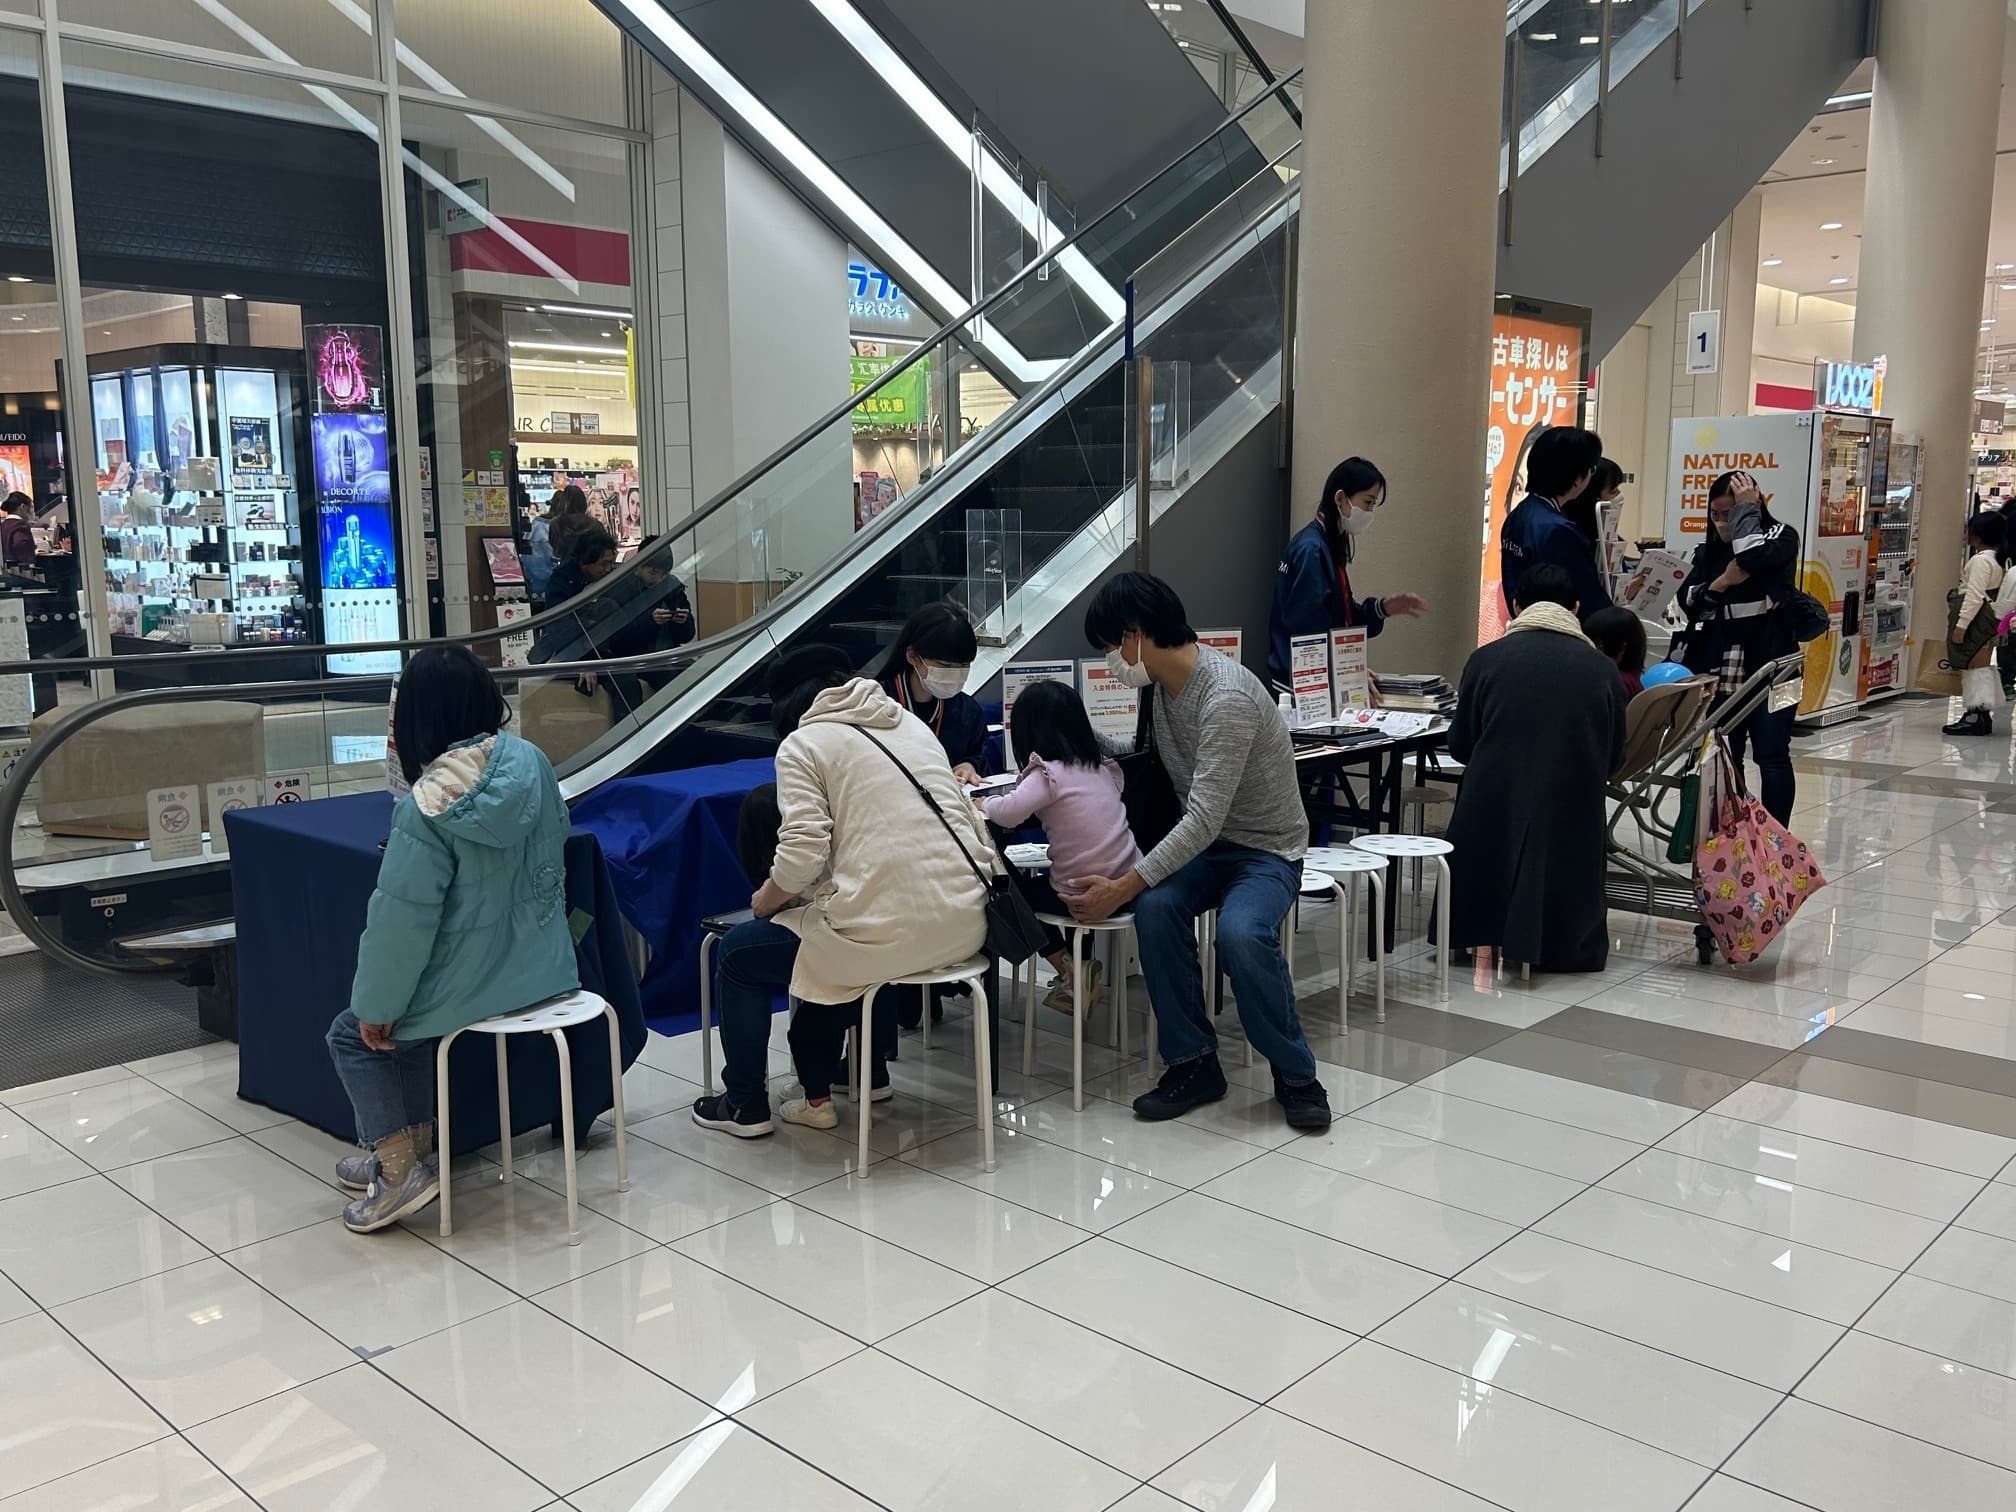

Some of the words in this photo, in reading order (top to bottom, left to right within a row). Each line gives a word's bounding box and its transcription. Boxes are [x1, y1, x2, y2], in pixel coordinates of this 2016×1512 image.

[1697, 332, 1706, 352] 1
[1490, 372, 1567, 426] ーセンサー
[513, 418, 533, 431] IR
[1684, 453, 1779, 470] NATURAL
[1682, 474, 1718, 490] FRE
[285, 779, 300, 788] 危険
